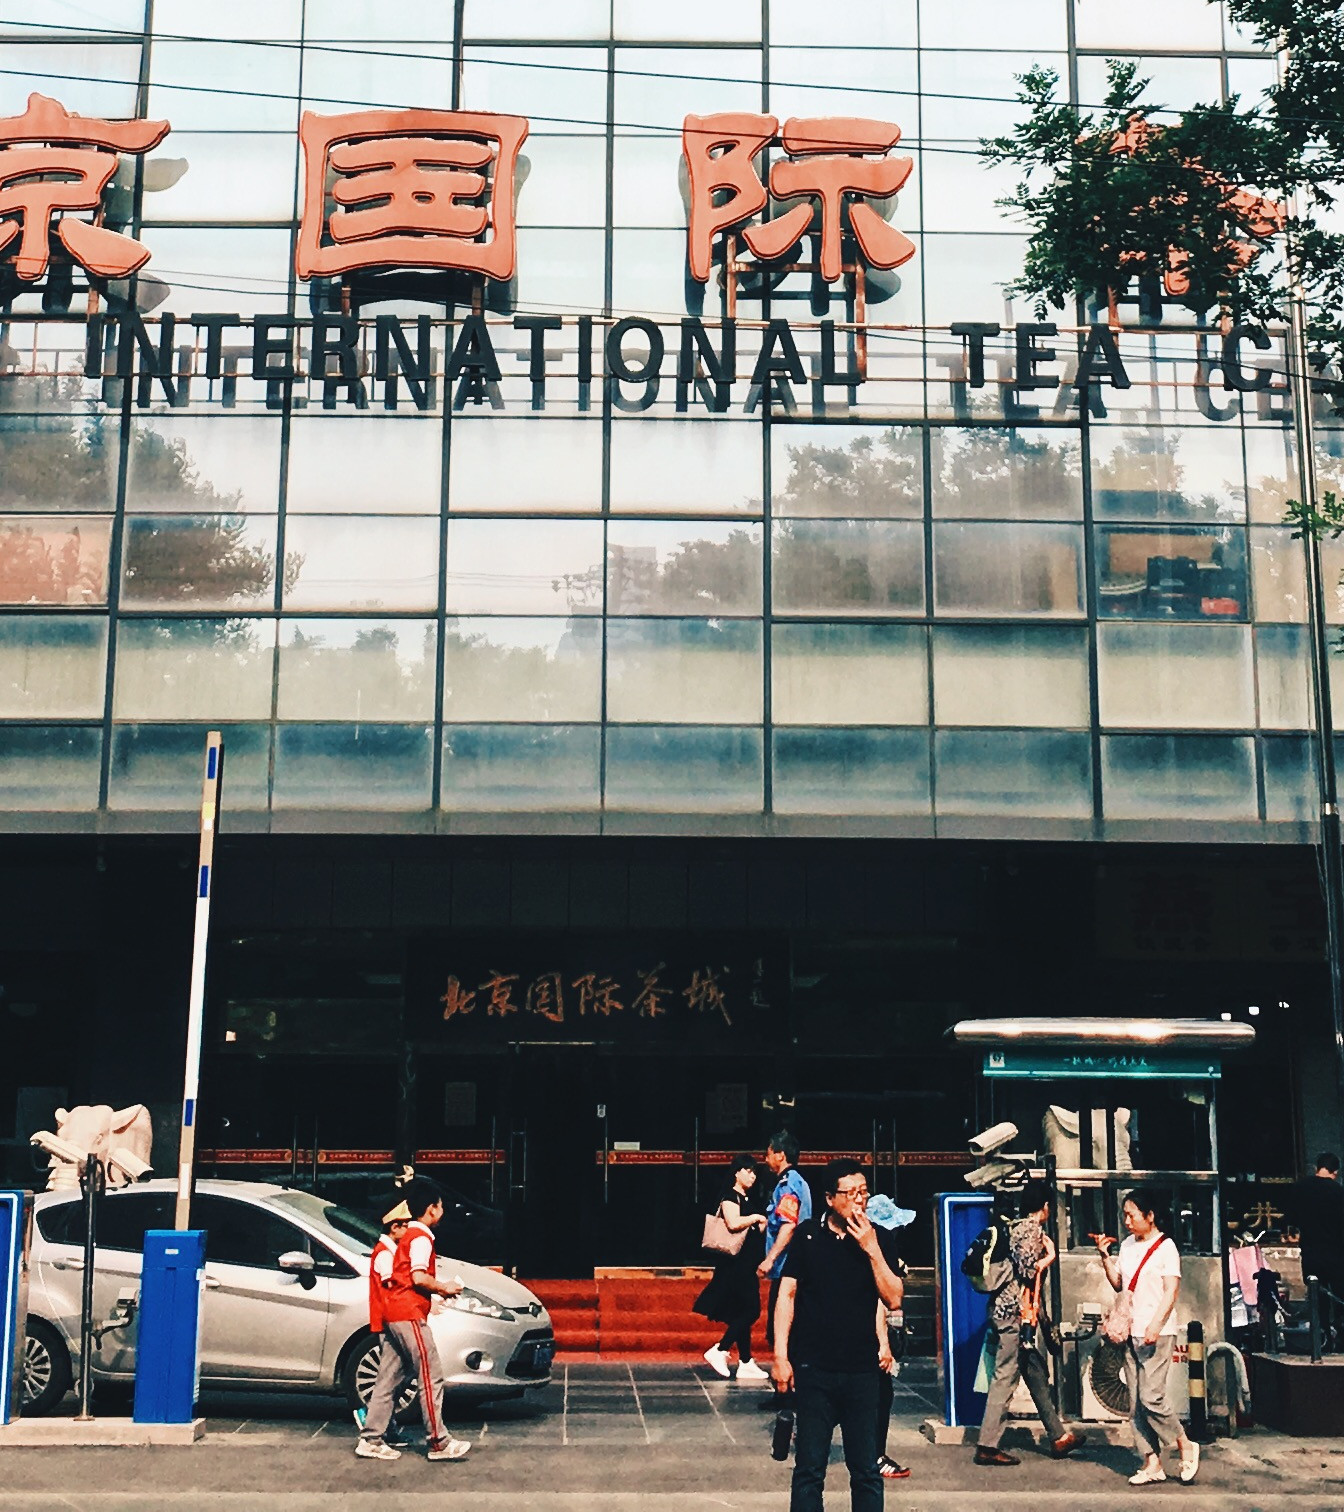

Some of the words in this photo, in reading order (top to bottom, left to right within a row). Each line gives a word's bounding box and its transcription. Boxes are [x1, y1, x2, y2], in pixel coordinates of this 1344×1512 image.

[84, 311, 859, 385] INTERNATIONAL
[950, 322, 1131, 390] TEA
[440, 960, 733, 1026] 北京国际茶城
